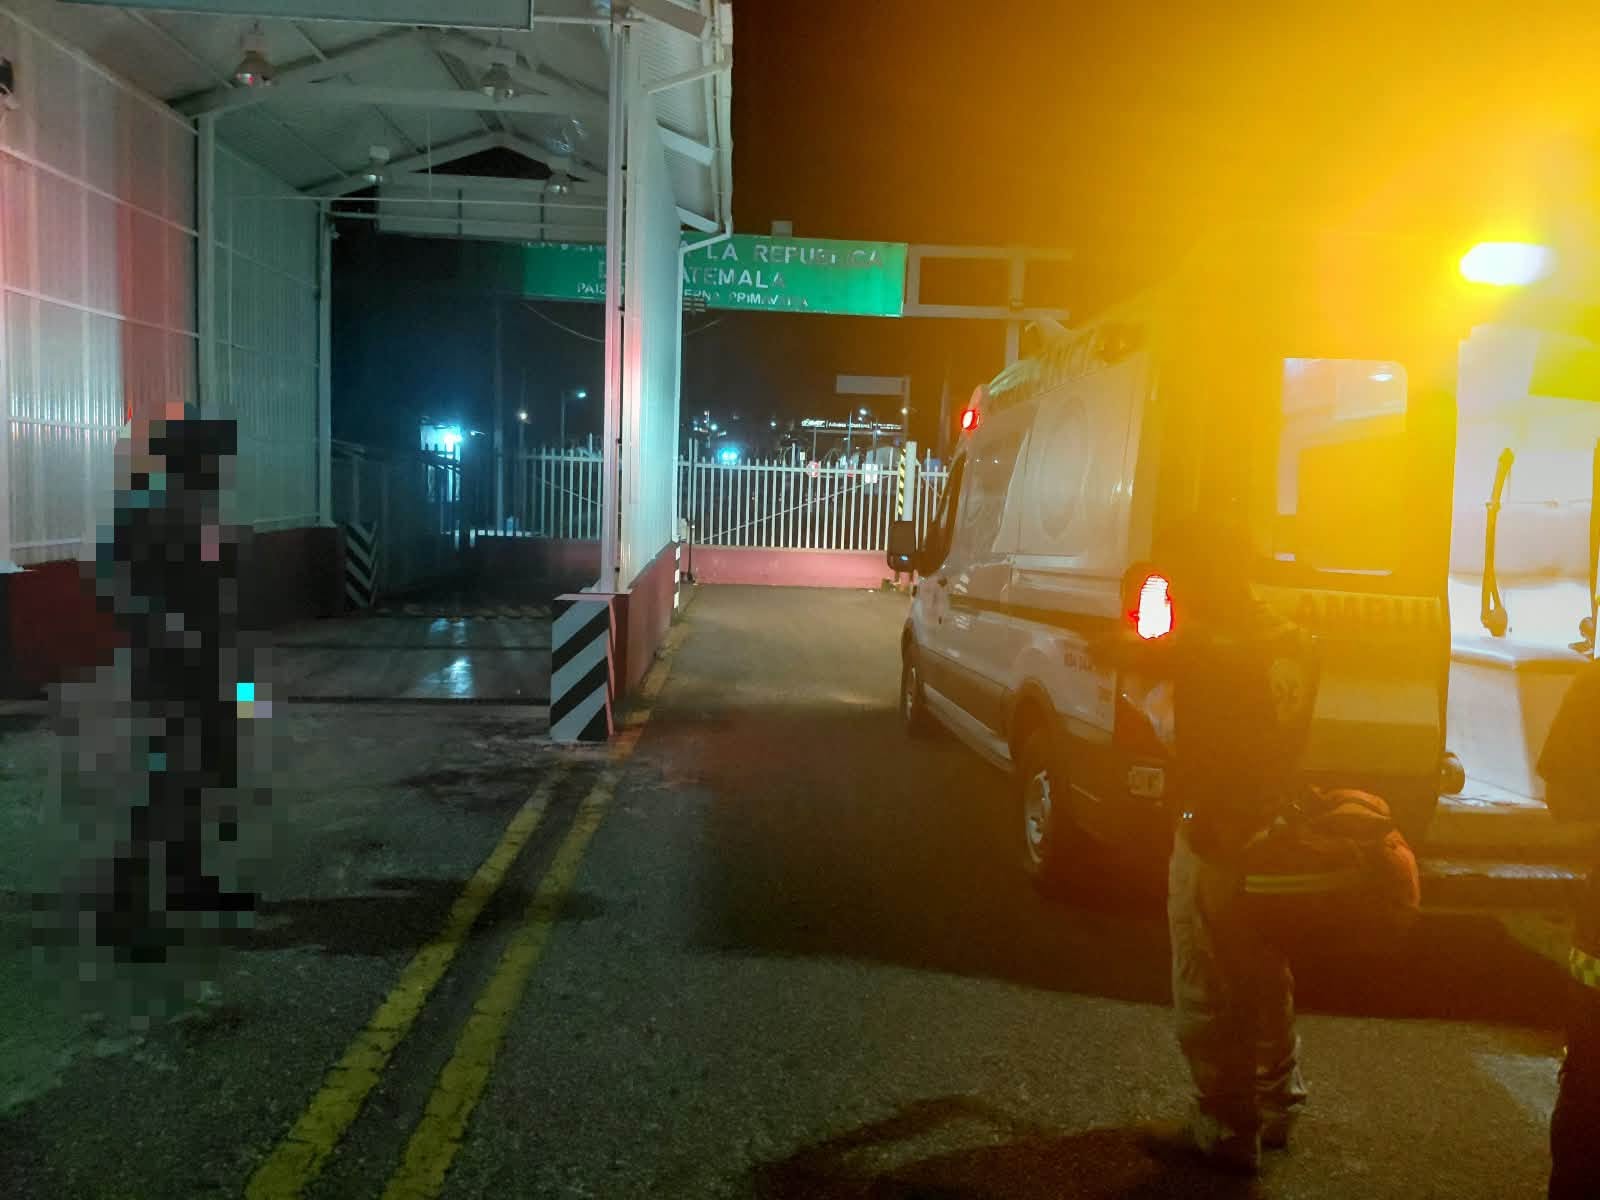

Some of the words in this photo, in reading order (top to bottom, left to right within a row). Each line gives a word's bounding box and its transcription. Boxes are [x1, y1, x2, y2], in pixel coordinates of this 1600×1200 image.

[706, 243, 738, 261] LA
[753, 244, 882, 267] REPUBCA
[682, 266, 785, 289] ATEMALA
